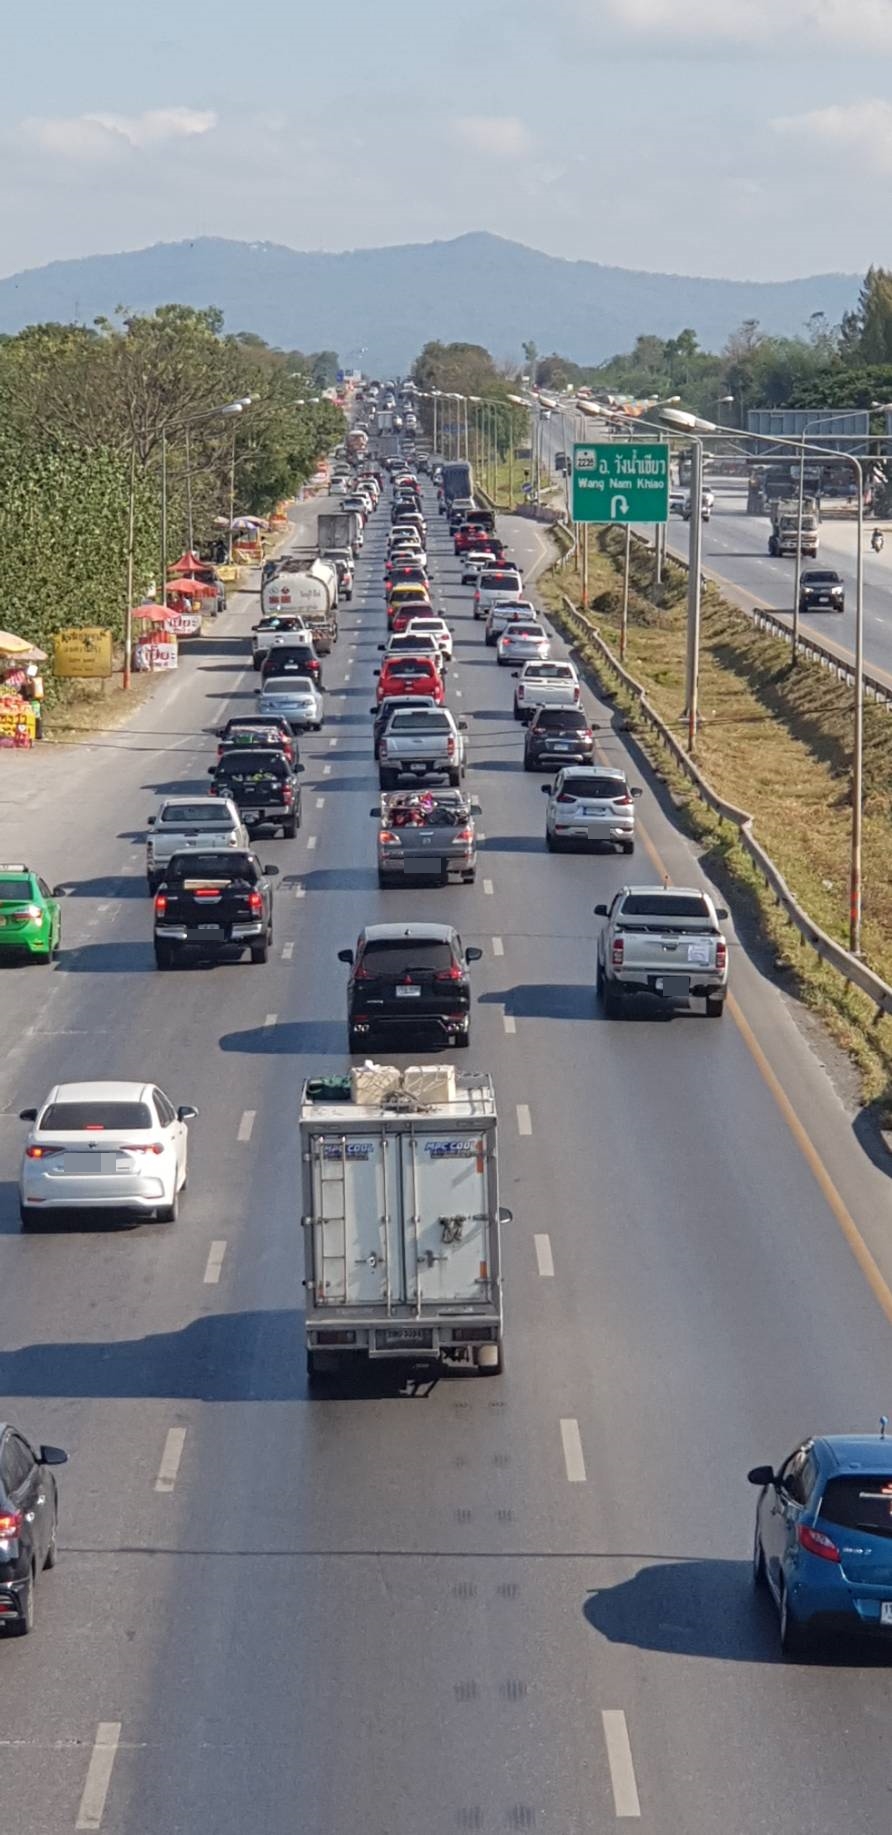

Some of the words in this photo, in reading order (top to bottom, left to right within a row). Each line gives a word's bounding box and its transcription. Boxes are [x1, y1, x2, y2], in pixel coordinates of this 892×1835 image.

[578, 477, 604, 491] Wang
[609, 478, 632, 489] Nam
[637, 478, 664, 489] Khiao
